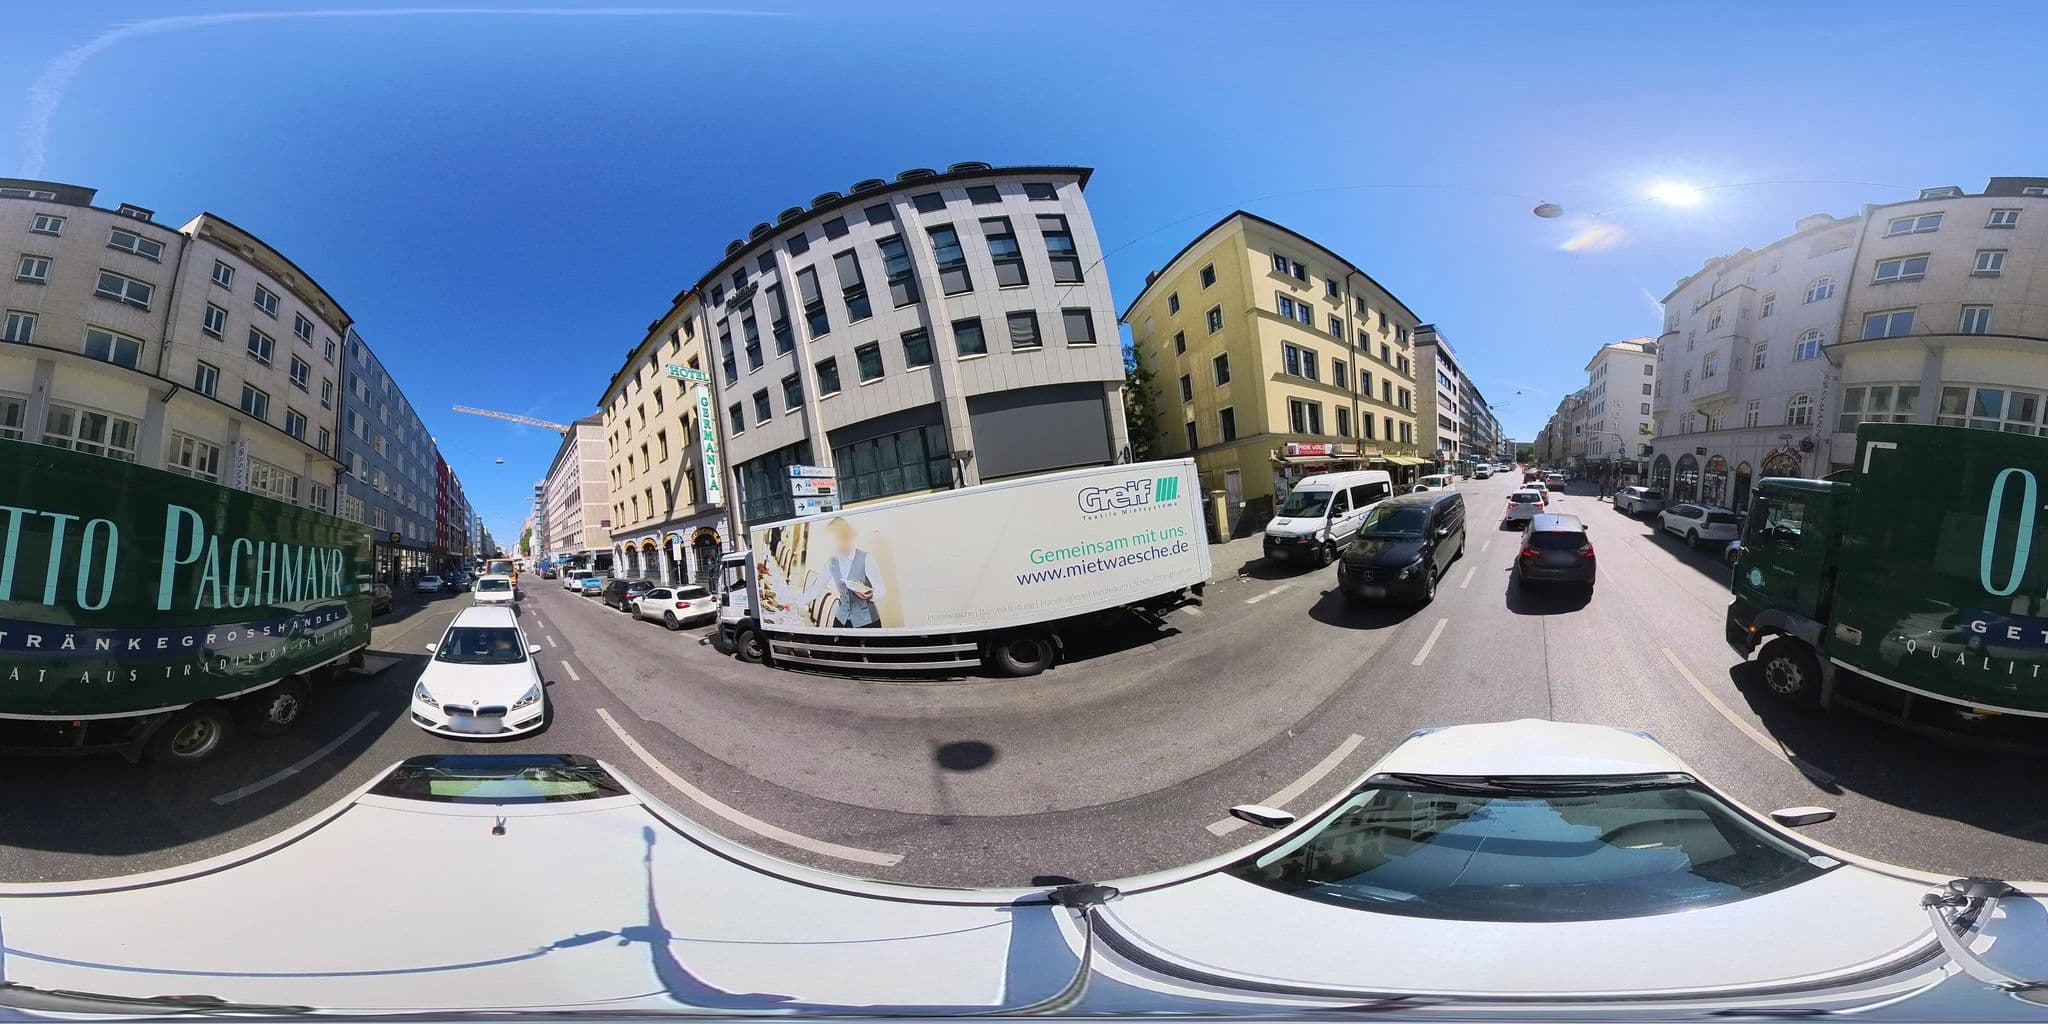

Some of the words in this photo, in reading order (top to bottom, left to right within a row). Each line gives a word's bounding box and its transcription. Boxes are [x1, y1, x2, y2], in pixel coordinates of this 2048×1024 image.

[670, 365, 709, 382] HOTEL
[1815, 373, 1830, 440] ROSSMANN
[700, 397, 720, 490] GERMANIA
[1078, 478, 1151, 514] Greif
[1082, 511, 1116, 521] Textile
[1121, 502, 1178, 515] Mietsysteme
[156, 503, 344, 611] PACHMAYR
[1016, 540, 1189, 586] www.mietwaesche.de
[1030, 535, 1129, 565] Gemeinsam
[1132, 529, 1157, 547] mit
[1160, 525, 1188, 541] uns.
[80, 669, 137, 684] AUS
[1906, 639, 2041, 678] QUALIT
